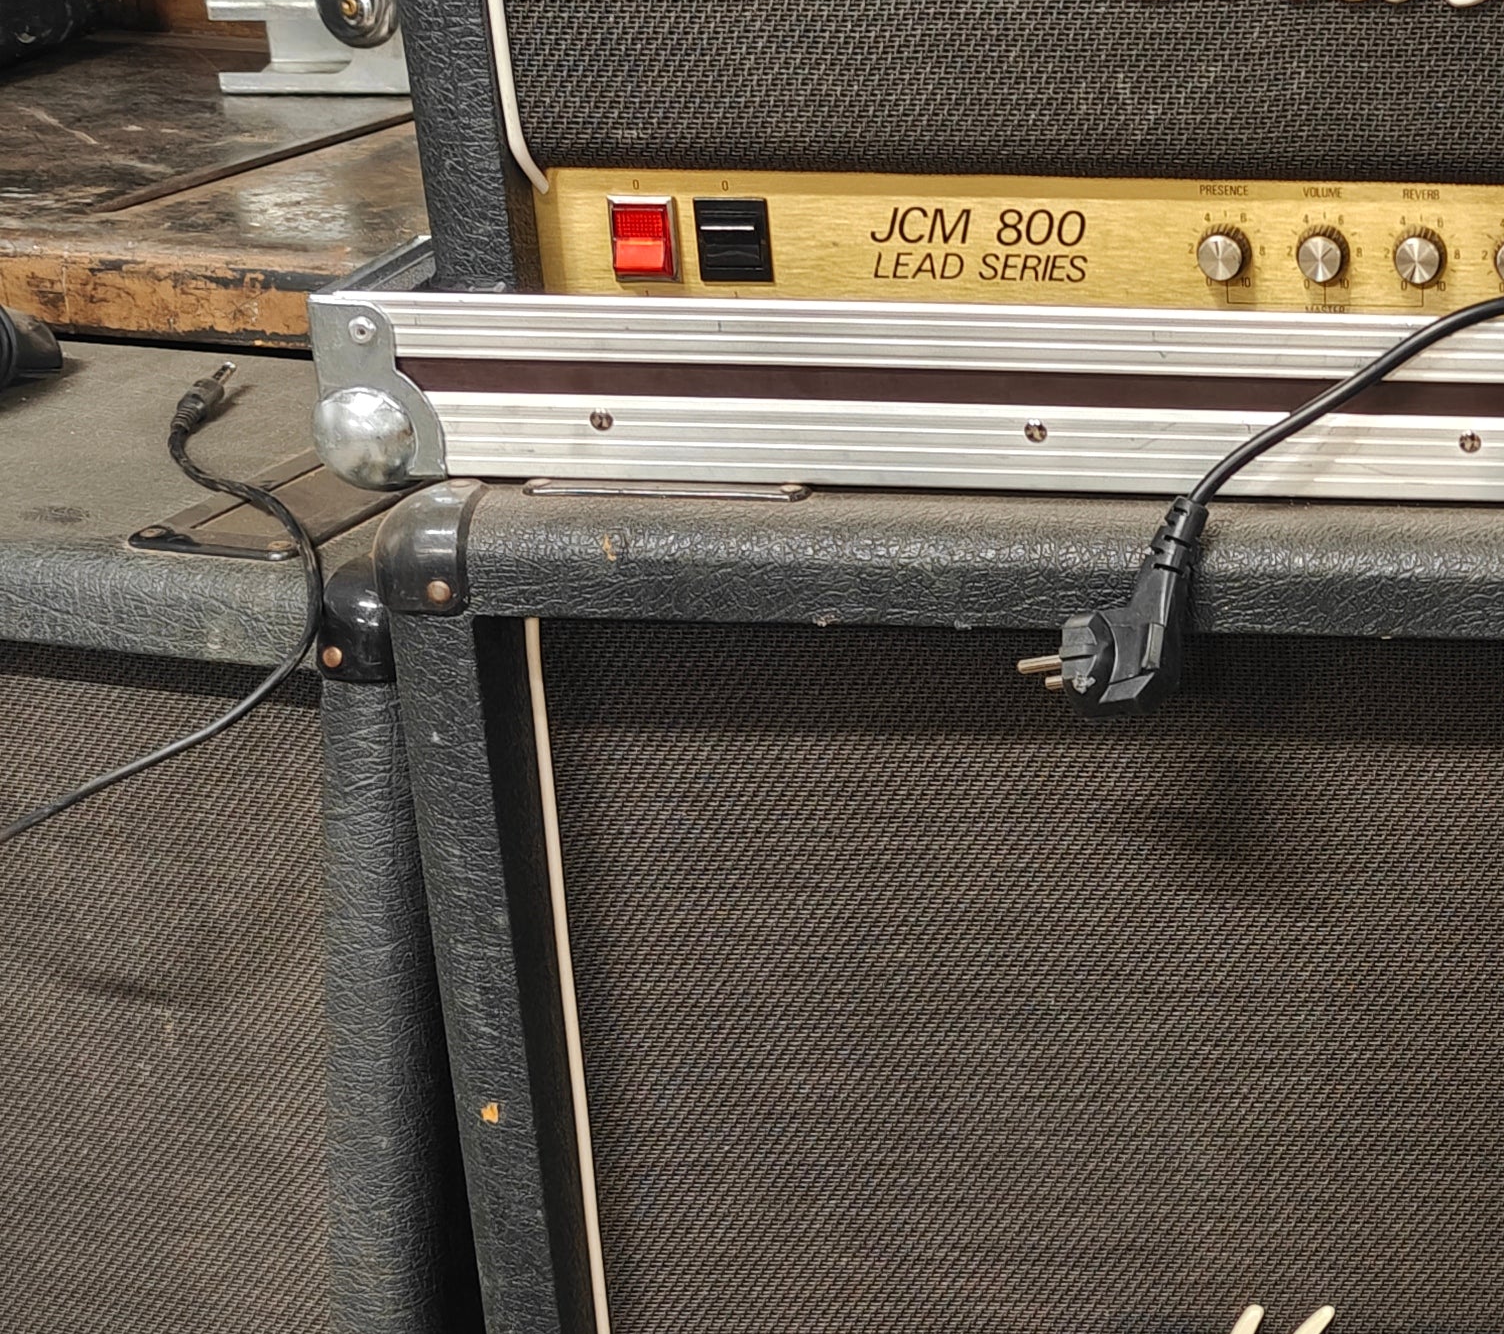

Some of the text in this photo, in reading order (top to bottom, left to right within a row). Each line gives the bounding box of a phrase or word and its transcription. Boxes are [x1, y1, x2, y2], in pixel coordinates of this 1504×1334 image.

[1200, 185, 1248, 195] PRESENCE
[1303, 187, 1342, 198] VOLUME
[1403, 189, 1440, 200] REVERB
[1204, 213, 1211, 222] 4
[1240, 213, 1247, 222] 6
[1303, 214, 1309, 224] 4
[1338, 215, 1344, 225] 6
[1400, 216, 1405, 225] 4
[1437, 217, 1443, 228] 6
[871, 206, 1087, 247] JCM 800
[1188, 243, 1194, 254] 2
[1259, 246, 1265, 255] 8
[1287, 246, 1292, 256] 2
[1356, 247, 1362, 257] 8
[1384, 250, 1390, 259] 2
[1454, 250, 1460, 259] 8
[1482, 251, 1488, 260] 2
[874, 251, 1088, 283] LEAD SERIES
[1206, 277, 1212, 286] 0
[1241, 277, 1250, 287] 10
[1304, 279, 1310, 289] 0
[1340, 279, 1349, 289] 10
[1401, 281, 1407, 291] 0
[1436, 281, 1445, 291] 10
[1499, 282, 1504, 292] 0
